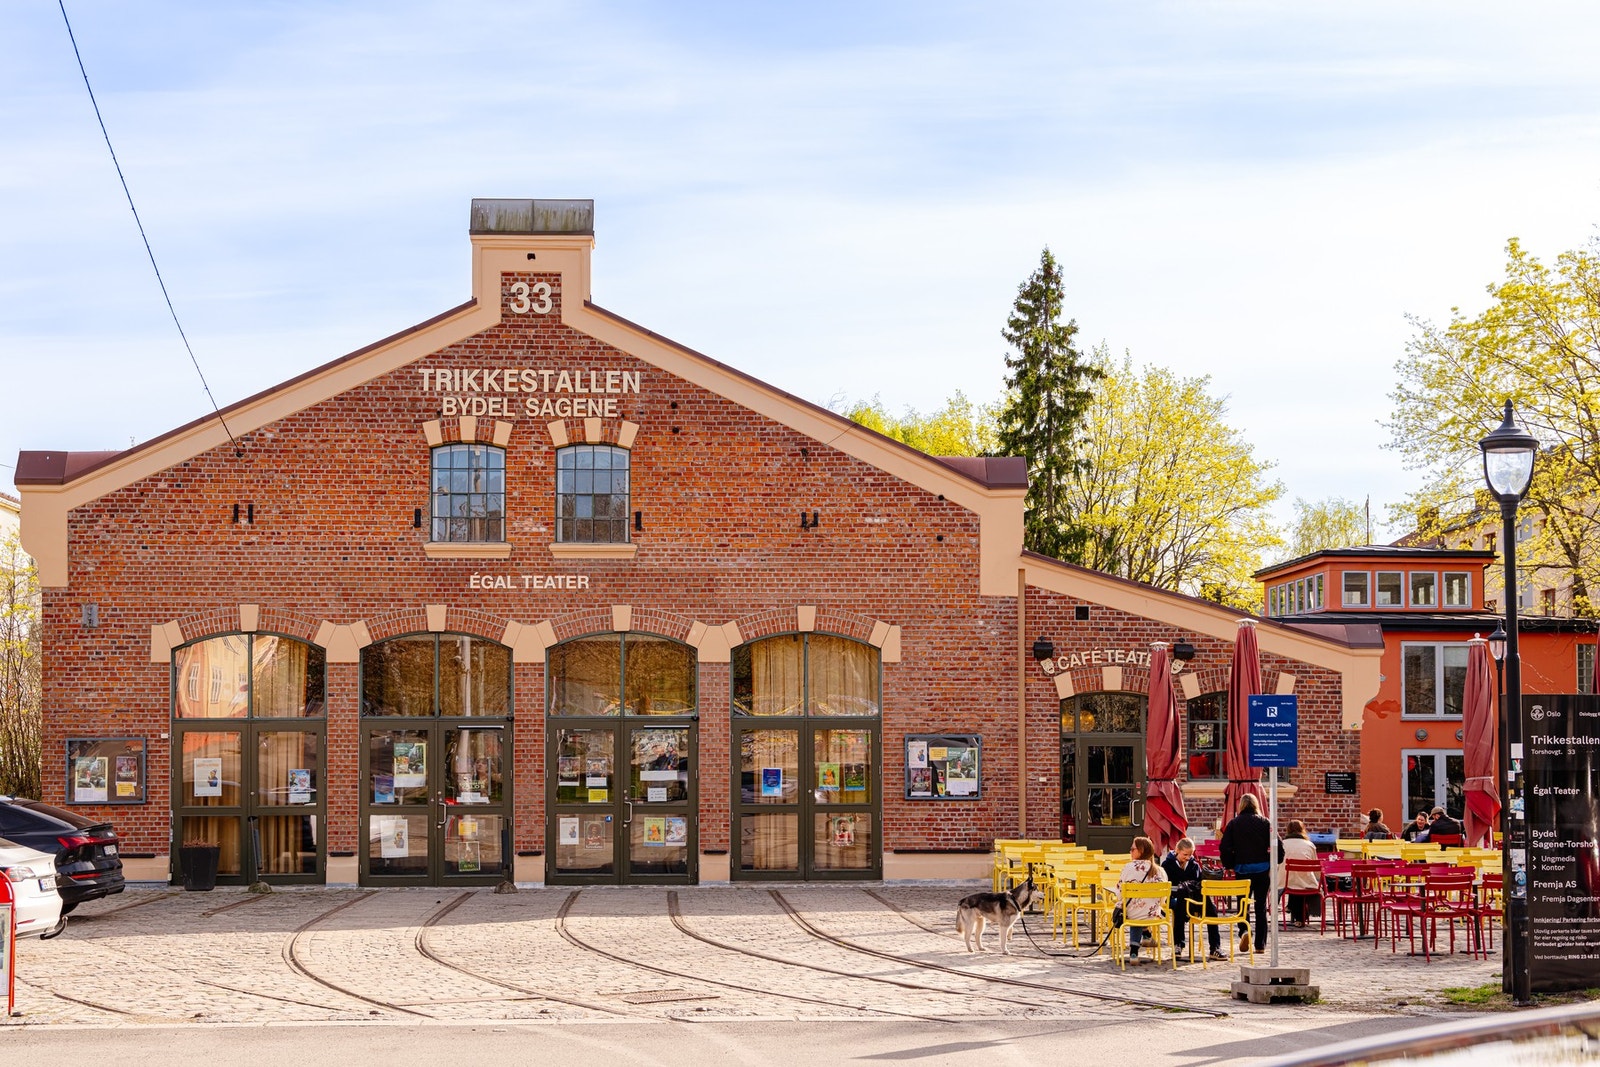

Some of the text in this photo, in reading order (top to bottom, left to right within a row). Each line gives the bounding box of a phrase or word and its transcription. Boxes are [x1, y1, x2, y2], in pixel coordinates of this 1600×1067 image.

[510, 281, 553, 314] 33
[418, 367, 641, 394] TRIKKESTALLEN
[442, 396, 618, 418] BYDEL SAGENE
[469, 571, 590, 589] ÉGAL TEATER
[1531, 735, 1600, 745] Trikkestallen
[1533, 785, 1580, 796] Égal Teater
[1532, 830, 1557, 839] Bydel
[1541, 855, 1576, 863] Ungmedia
[1533, 880, 1577, 890] Fremja AS
[1541, 895, 1566, 903] Fremja
